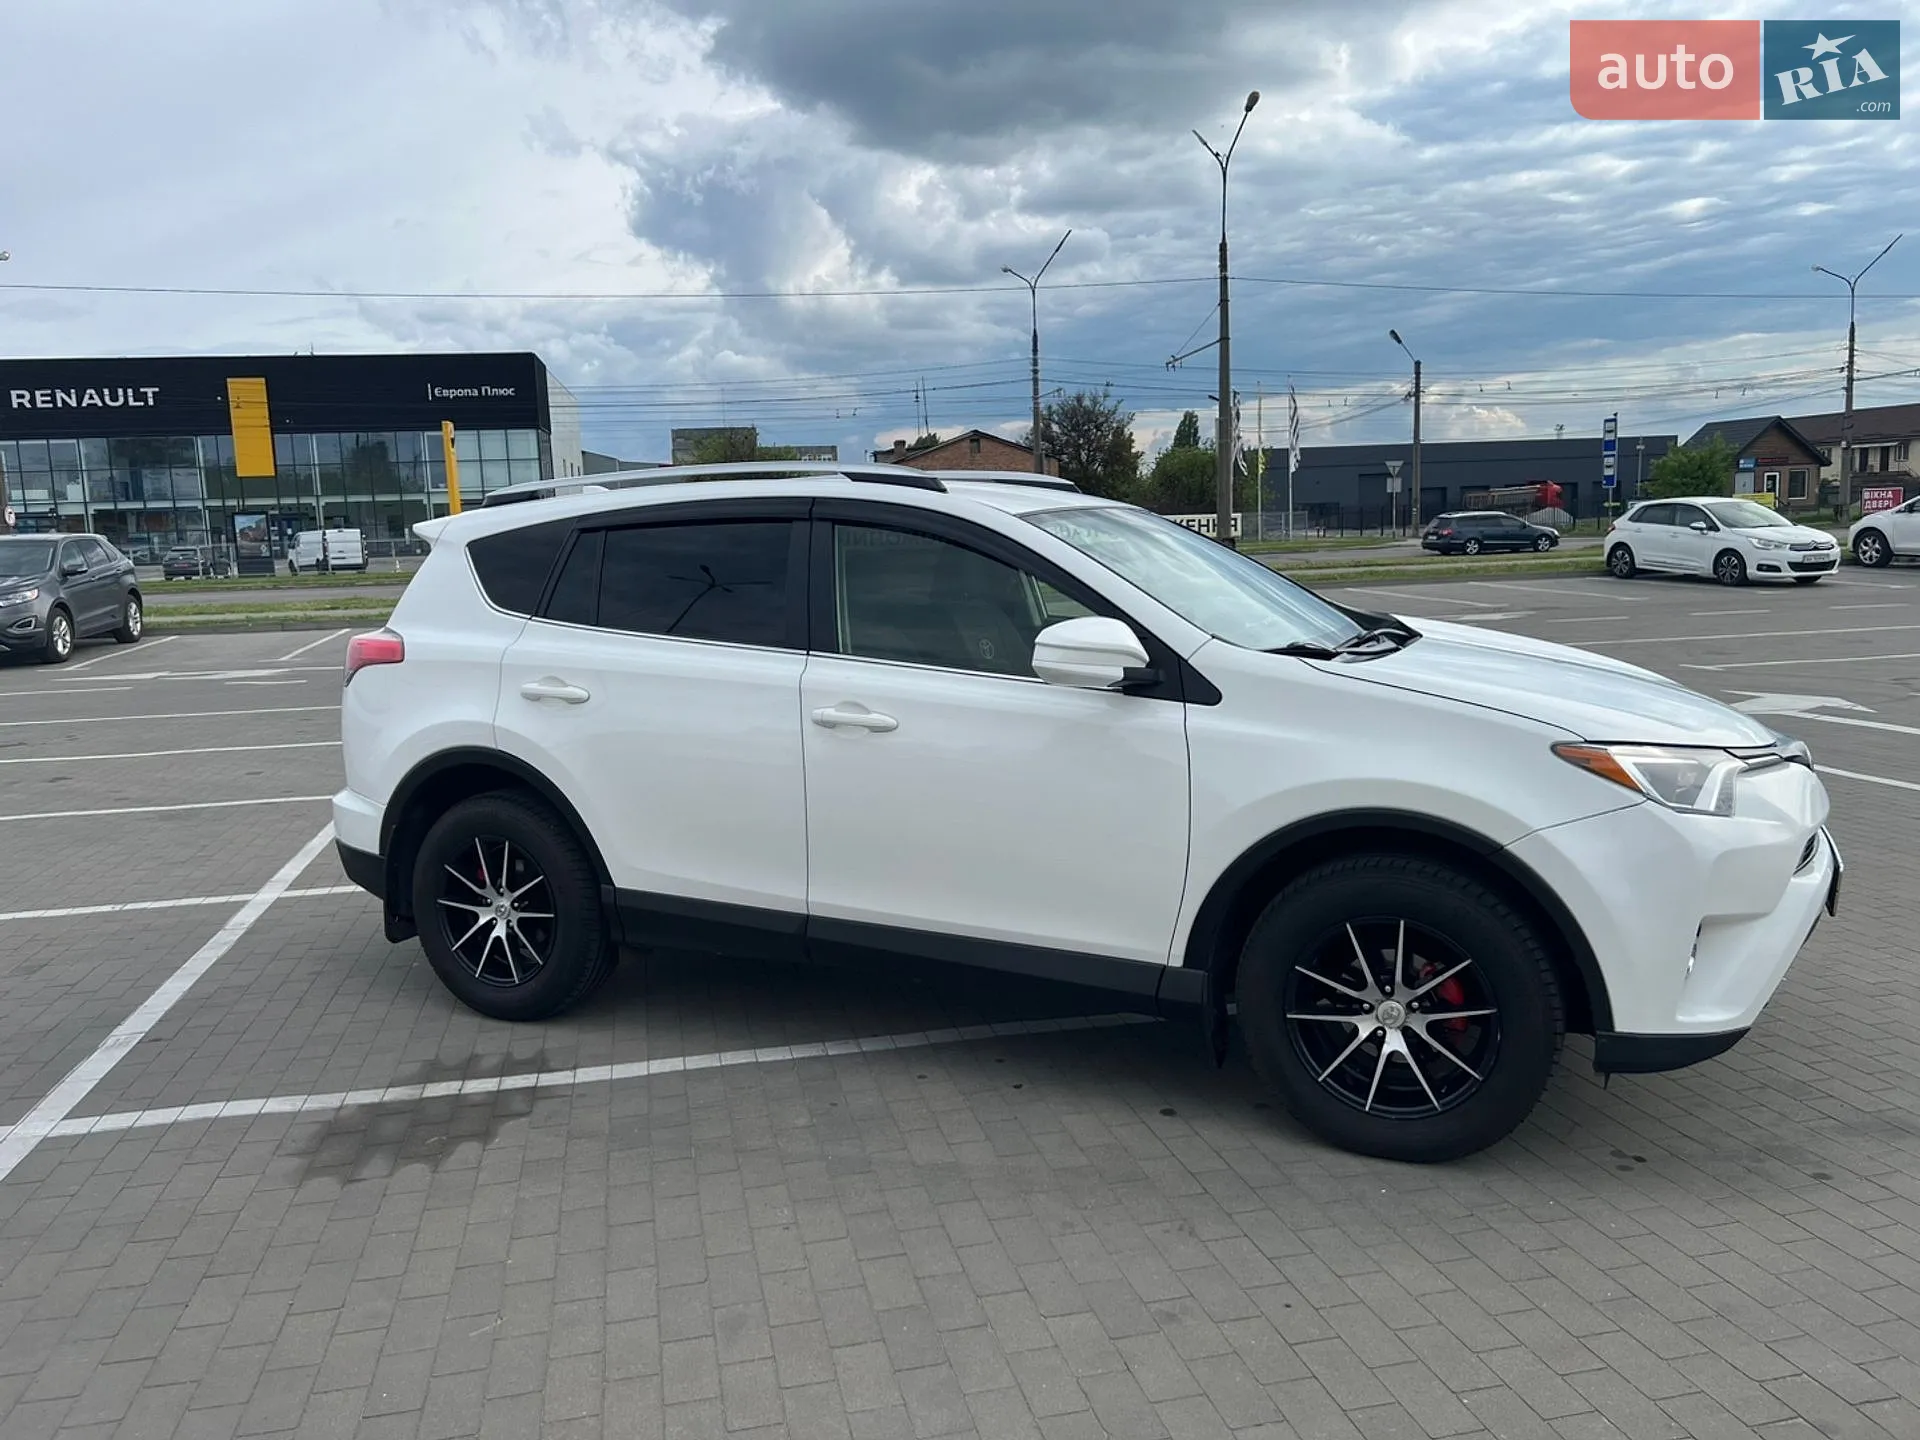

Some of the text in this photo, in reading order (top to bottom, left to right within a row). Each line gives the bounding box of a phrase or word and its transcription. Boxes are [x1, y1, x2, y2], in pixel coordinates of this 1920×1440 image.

[9, 387, 160, 409] RENAULT
[434, 385, 517, 399] Європа Плюс
[1864, 499, 1894, 510] ДВЕРІ
